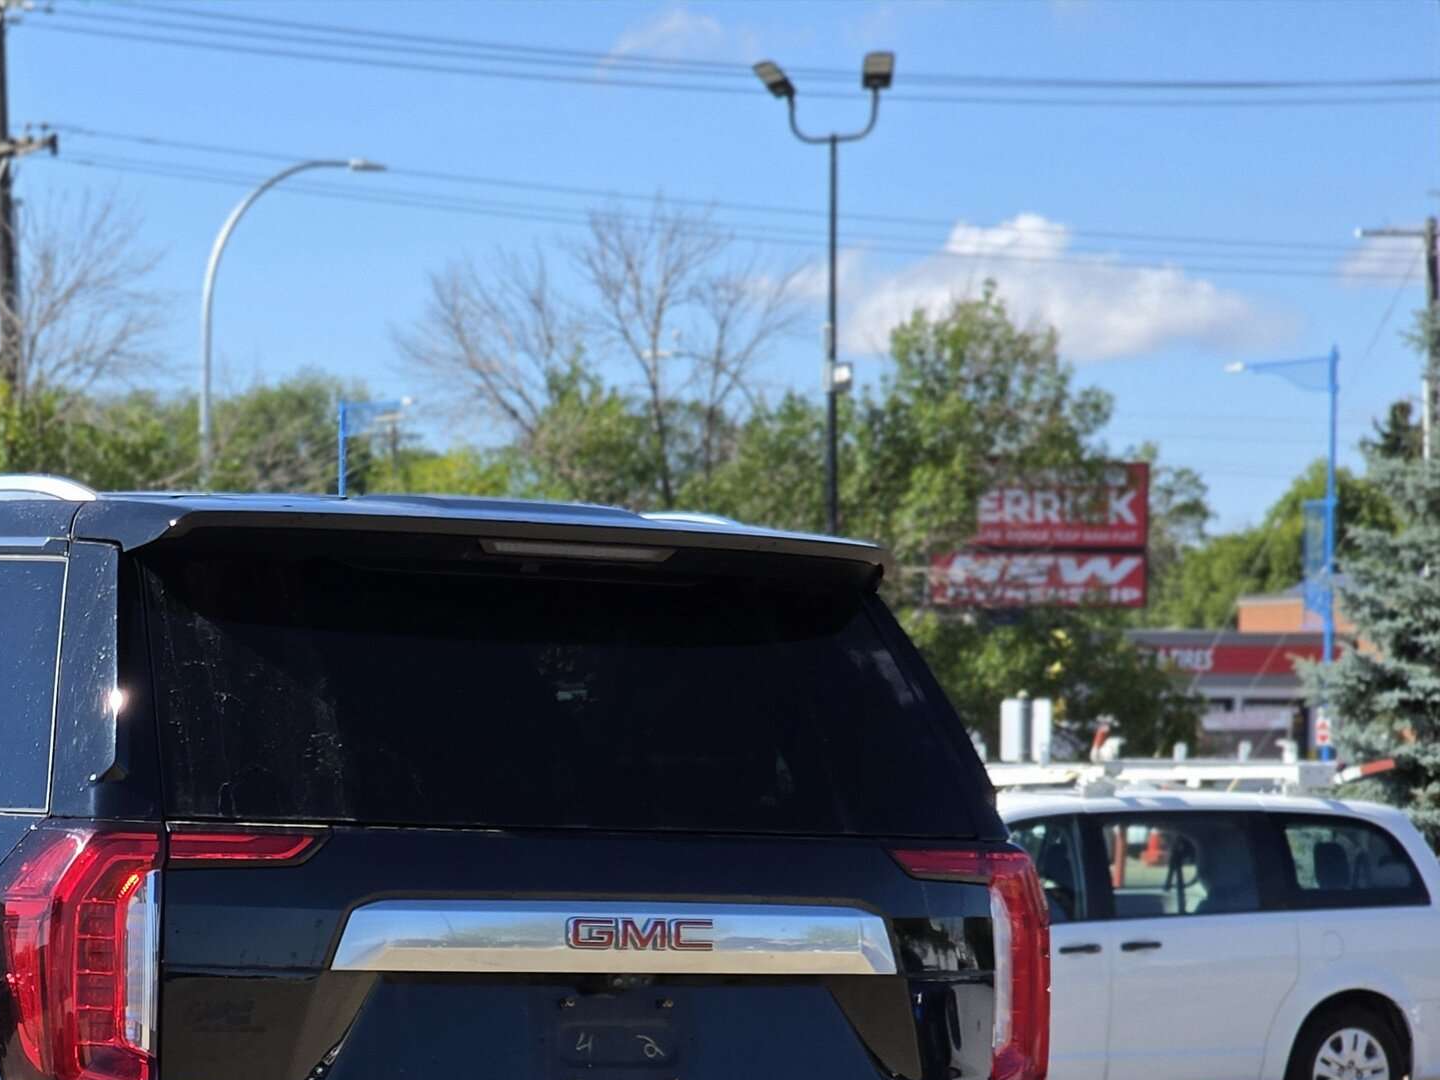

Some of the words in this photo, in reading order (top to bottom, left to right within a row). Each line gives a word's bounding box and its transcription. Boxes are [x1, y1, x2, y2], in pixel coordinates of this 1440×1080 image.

[948, 555, 1142, 583] NEW
[1169, 649, 1213, 671] TIRES
[566, 915, 713, 951] GMC
